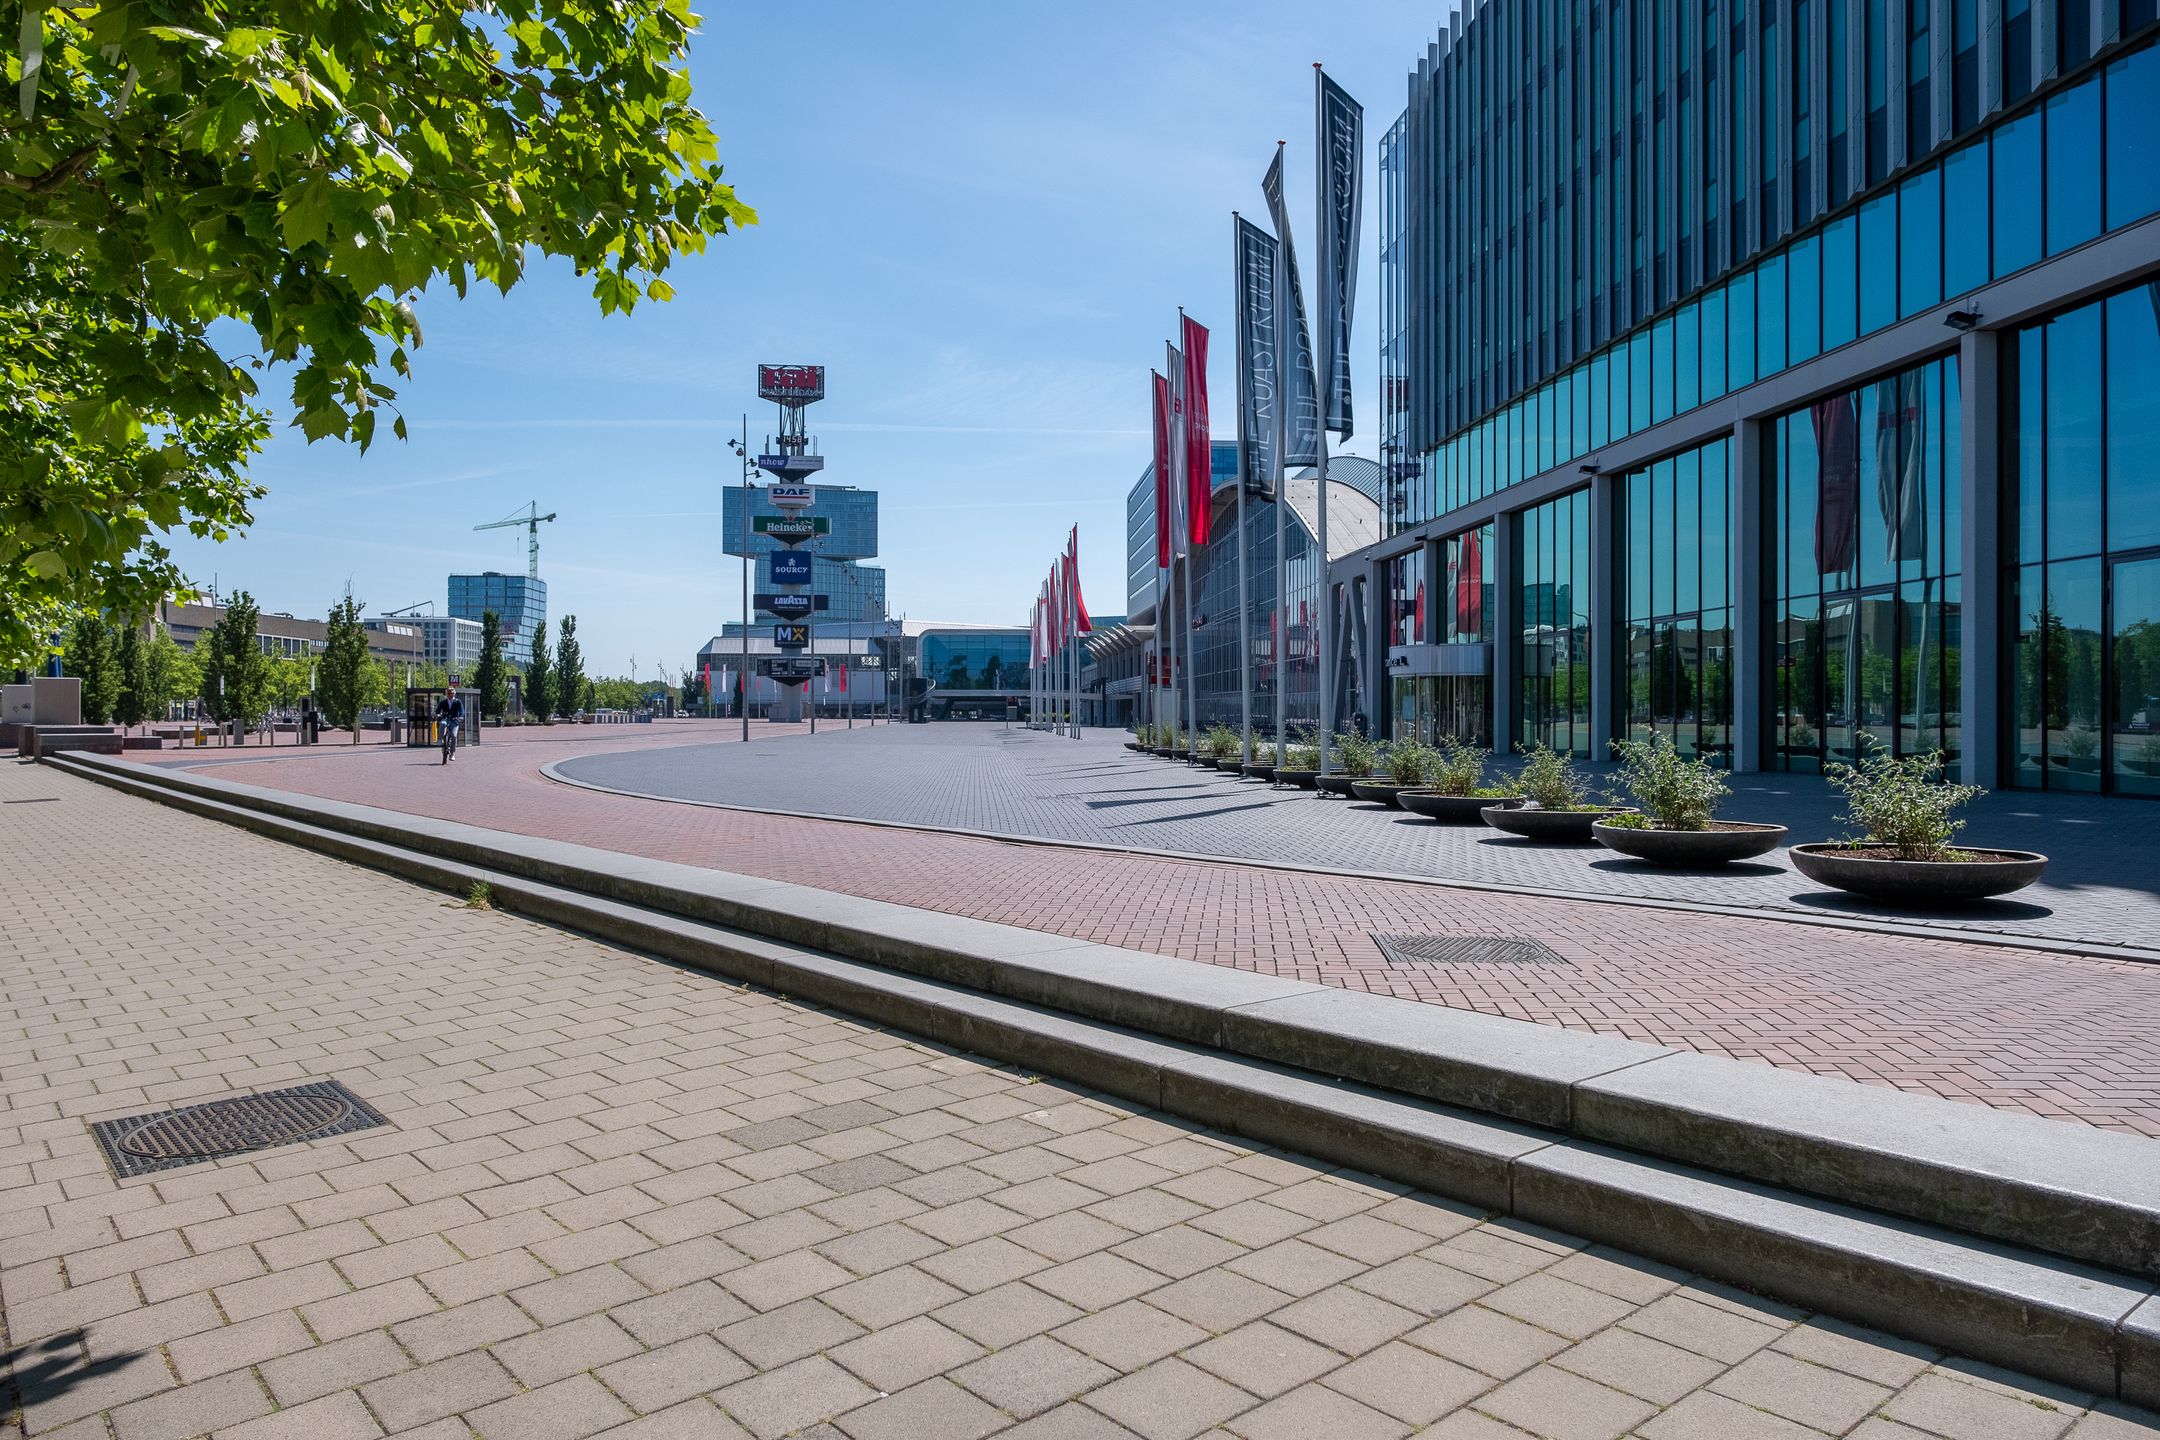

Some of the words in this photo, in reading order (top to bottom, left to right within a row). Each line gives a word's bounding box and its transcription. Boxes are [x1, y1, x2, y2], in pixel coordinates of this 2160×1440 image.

[760, 457, 785, 466] nhow
[773, 488, 810, 496] DAF
[774, 595, 809, 605] LAVAZZA
